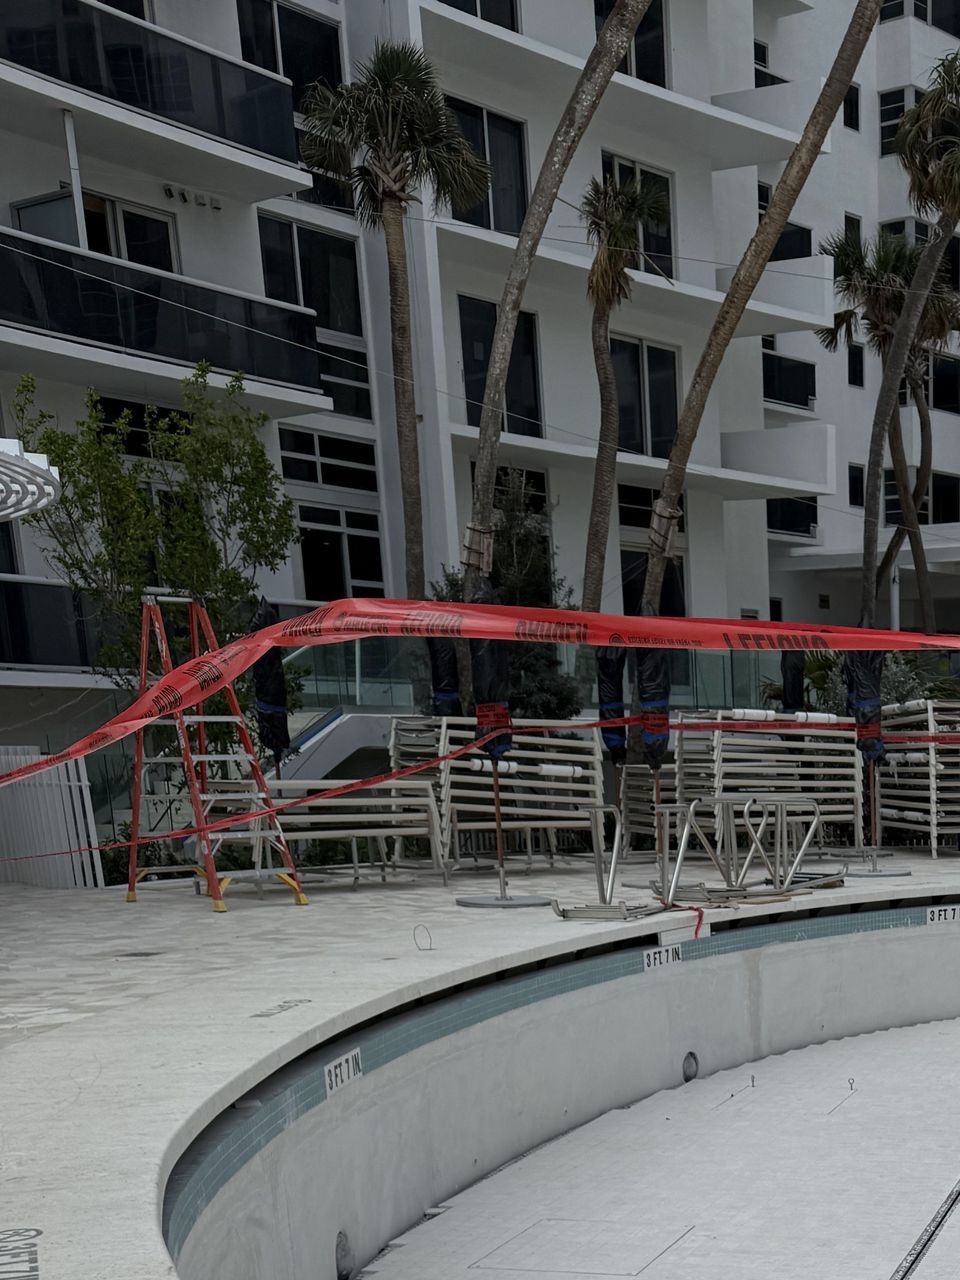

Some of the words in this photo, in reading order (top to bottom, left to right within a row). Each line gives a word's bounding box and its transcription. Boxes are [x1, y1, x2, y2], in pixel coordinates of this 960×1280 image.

[930, 910, 935, 921] 3
[951, 908, 956, 920] 7
[646, 953, 651, 968] 3
[665, 948, 669, 963] 7
[327, 1068, 333, 1091] 3
[345, 1057, 350, 1080] 7
